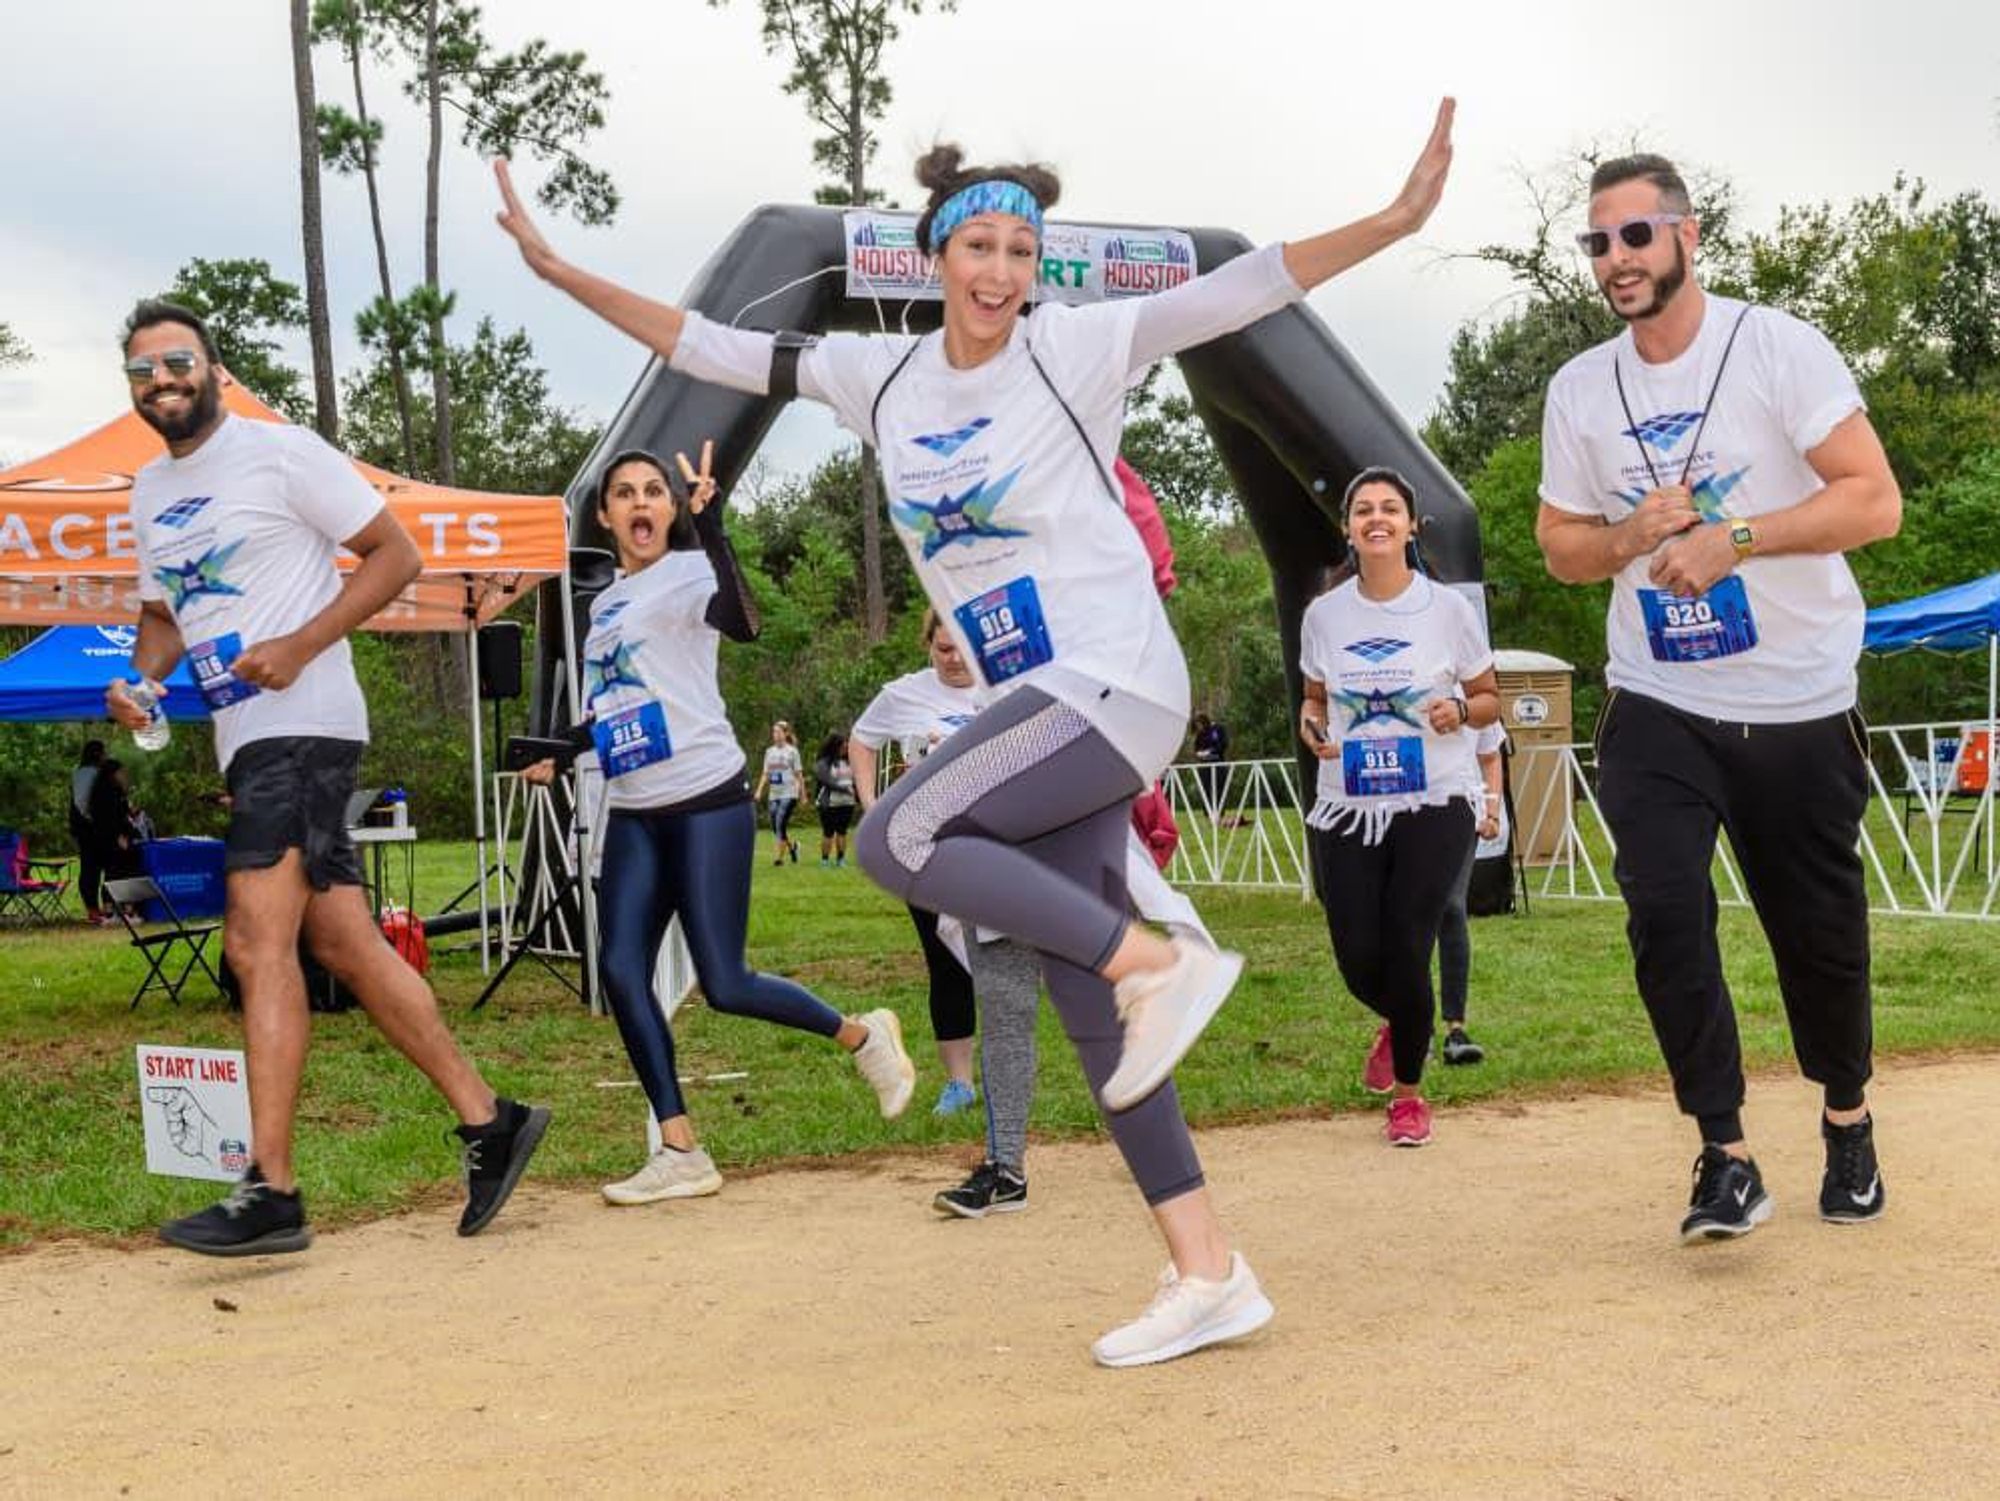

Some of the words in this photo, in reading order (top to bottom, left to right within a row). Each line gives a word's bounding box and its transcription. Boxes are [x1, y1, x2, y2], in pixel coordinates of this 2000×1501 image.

[980, 607, 1014, 640] 919
[1665, 601, 1712, 626] 920
[613, 721, 643, 746] 915
[1365, 751, 1398, 768] 913
[146, 1056, 195, 1079] START
[200, 1059, 238, 1083] LINE
